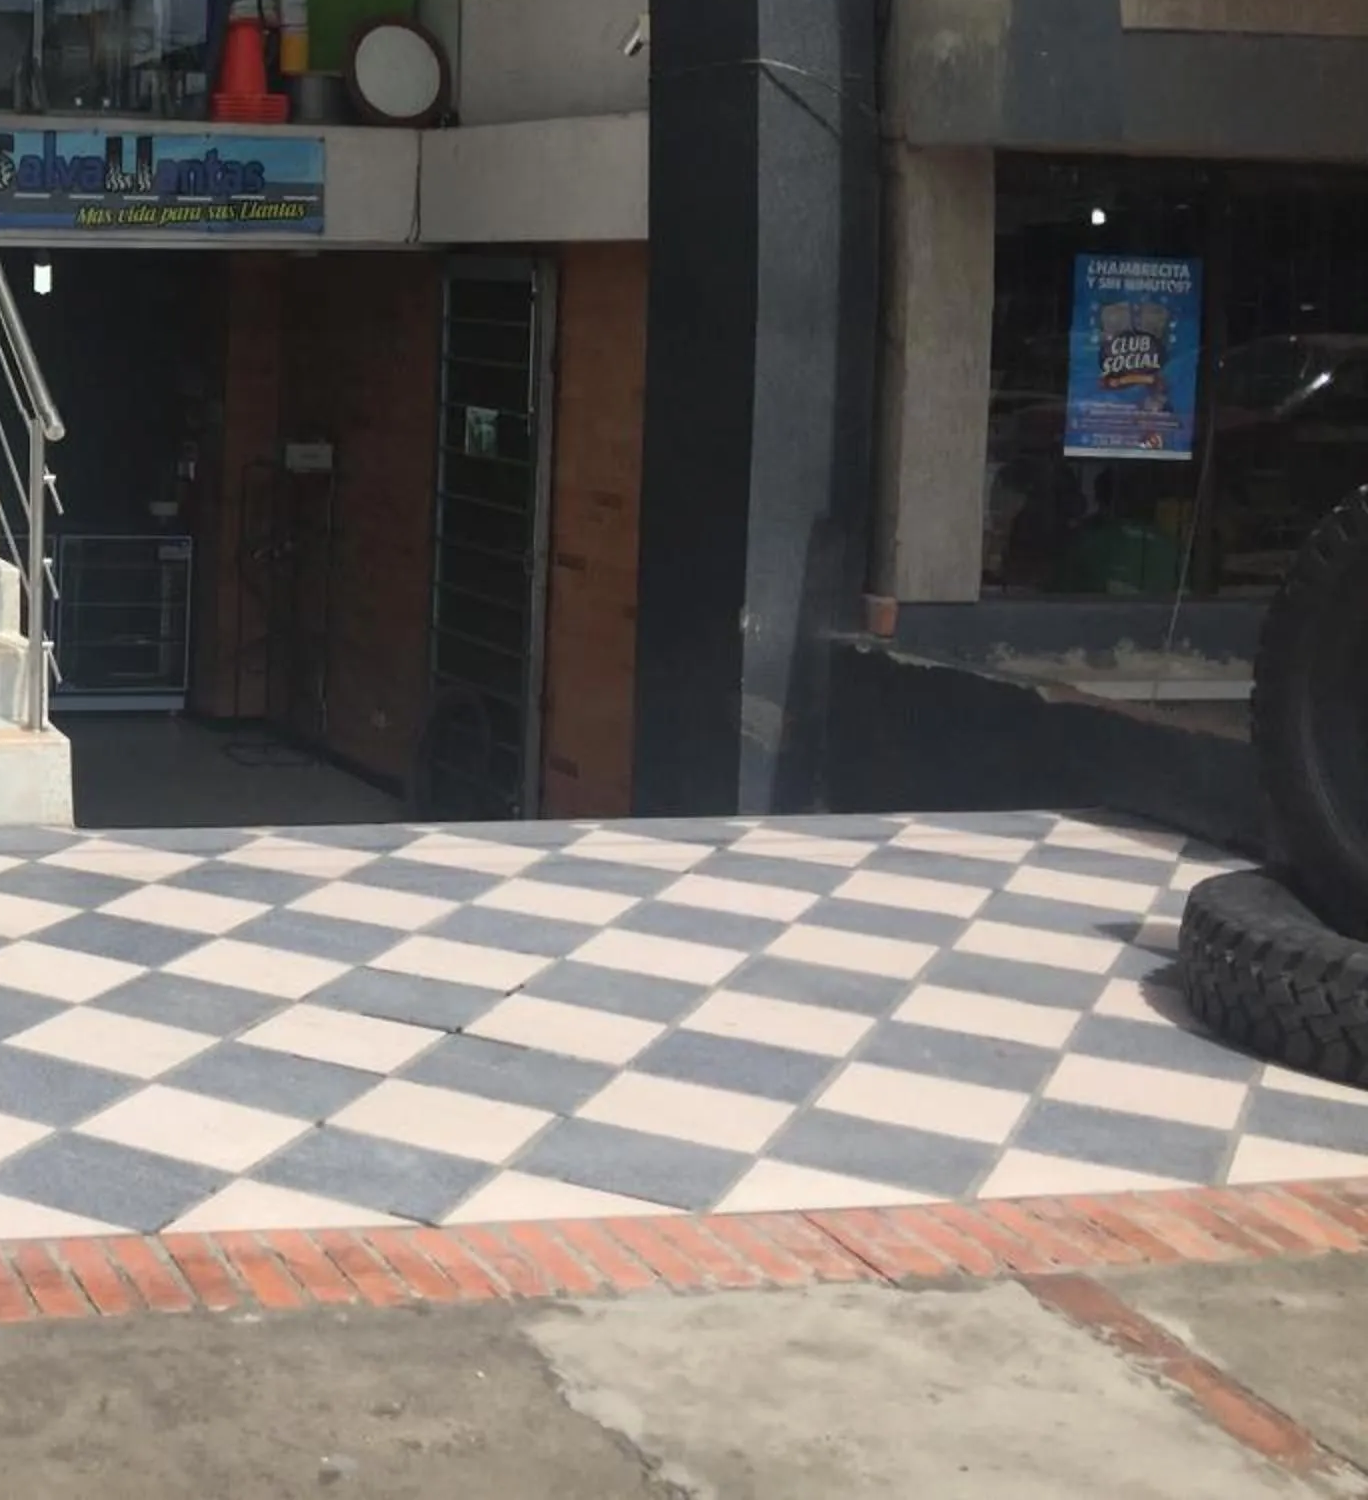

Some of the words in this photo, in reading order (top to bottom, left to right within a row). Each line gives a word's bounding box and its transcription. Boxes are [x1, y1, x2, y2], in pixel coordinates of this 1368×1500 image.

[75, 206, 114, 227] Mas
[118, 203, 156, 224] vida
[160, 204, 202, 226] para
[208, 204, 235, 221] sus
[239, 201, 306, 221] Llantas
[1087, 278, 1098, 289] Y
[1111, 335, 1151, 355] CLUB
[1103, 353, 1160, 375] SOCIAL
